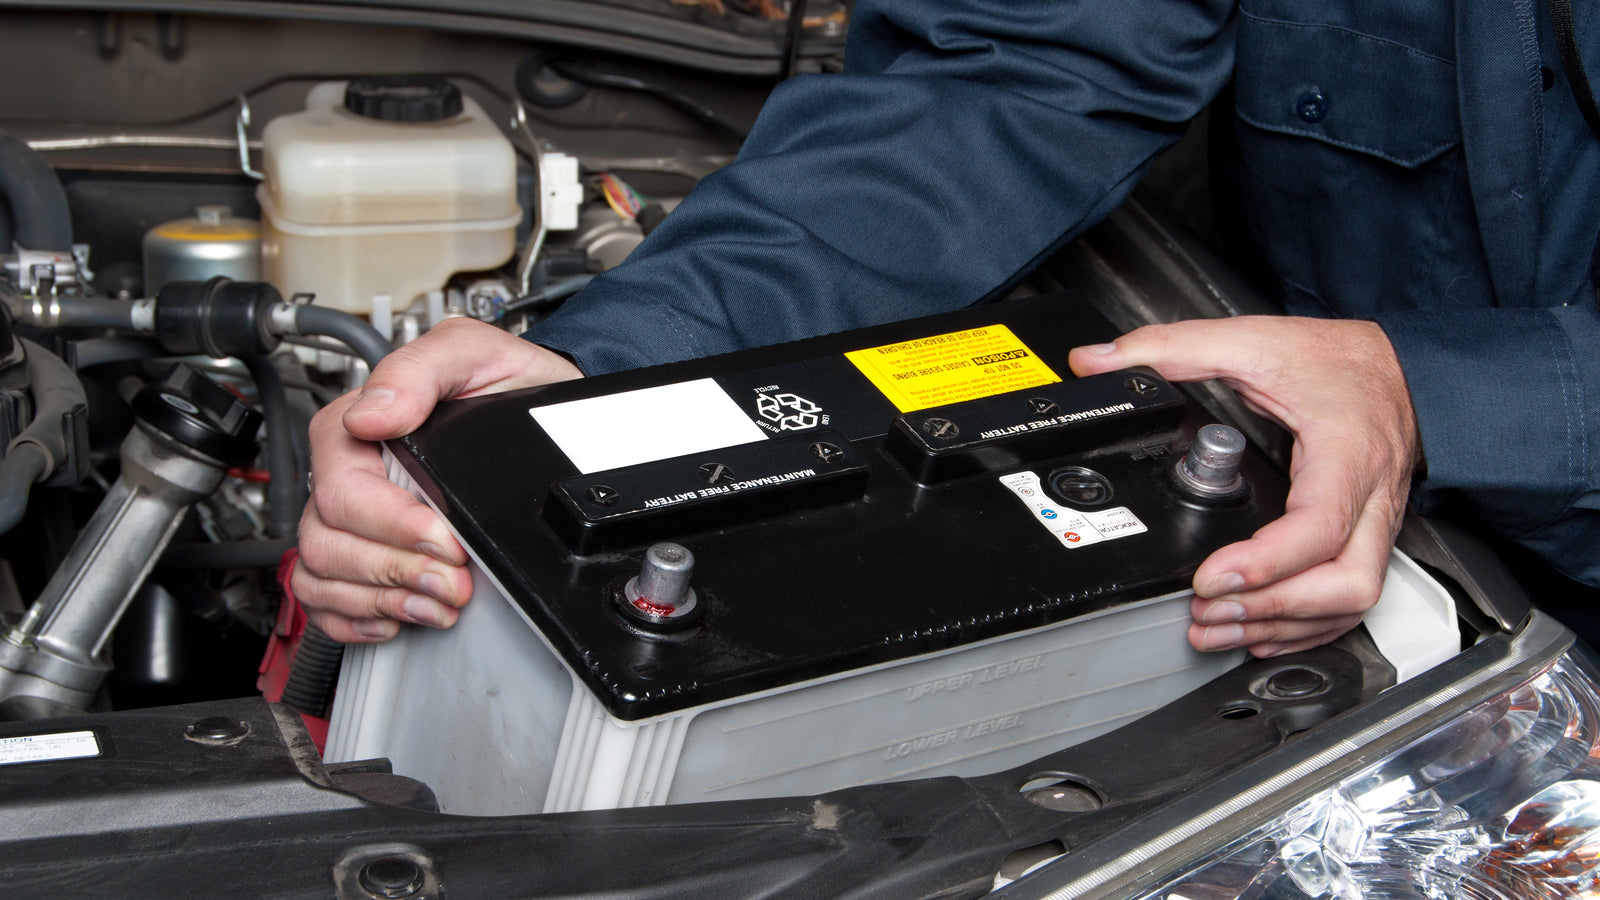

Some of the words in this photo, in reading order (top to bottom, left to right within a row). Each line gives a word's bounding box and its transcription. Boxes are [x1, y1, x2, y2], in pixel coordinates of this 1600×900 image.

[955, 332, 971, 340] OUT
[972, 329, 987, 337] KEEP
[920, 336, 946, 345] REACH
[876, 343, 912, 354] CHILDREN
[973, 351, 1016, 364] POISON
[916, 365, 943, 375] SEVERE
[942, 360, 971, 370] CAUSES
[983, 366, 995, 374] TIP
[1009, 361, 1022, 369] DO
[892, 370, 918, 380] BURNS
[753, 384, 780, 393] RECYCLE
[1057, 402, 1135, 423] MAINTENANCE
[755, 420, 781, 433] RETURN
[1027, 418, 1058, 430] FREE
[980, 423, 1029, 440] BATTERY
[730, 468, 816, 491] MAINTENANCE
[697, 485, 731, 498] FREE
[644, 491, 698, 508] BATTERY
[1099, 521, 1138, 533] INDICATOR
[905, 672, 975, 703] UPPER
[979, 655, 1046, 685] LEVEL
[884, 730, 961, 761] LOWER
[964, 713, 1025, 741] LEVEL
